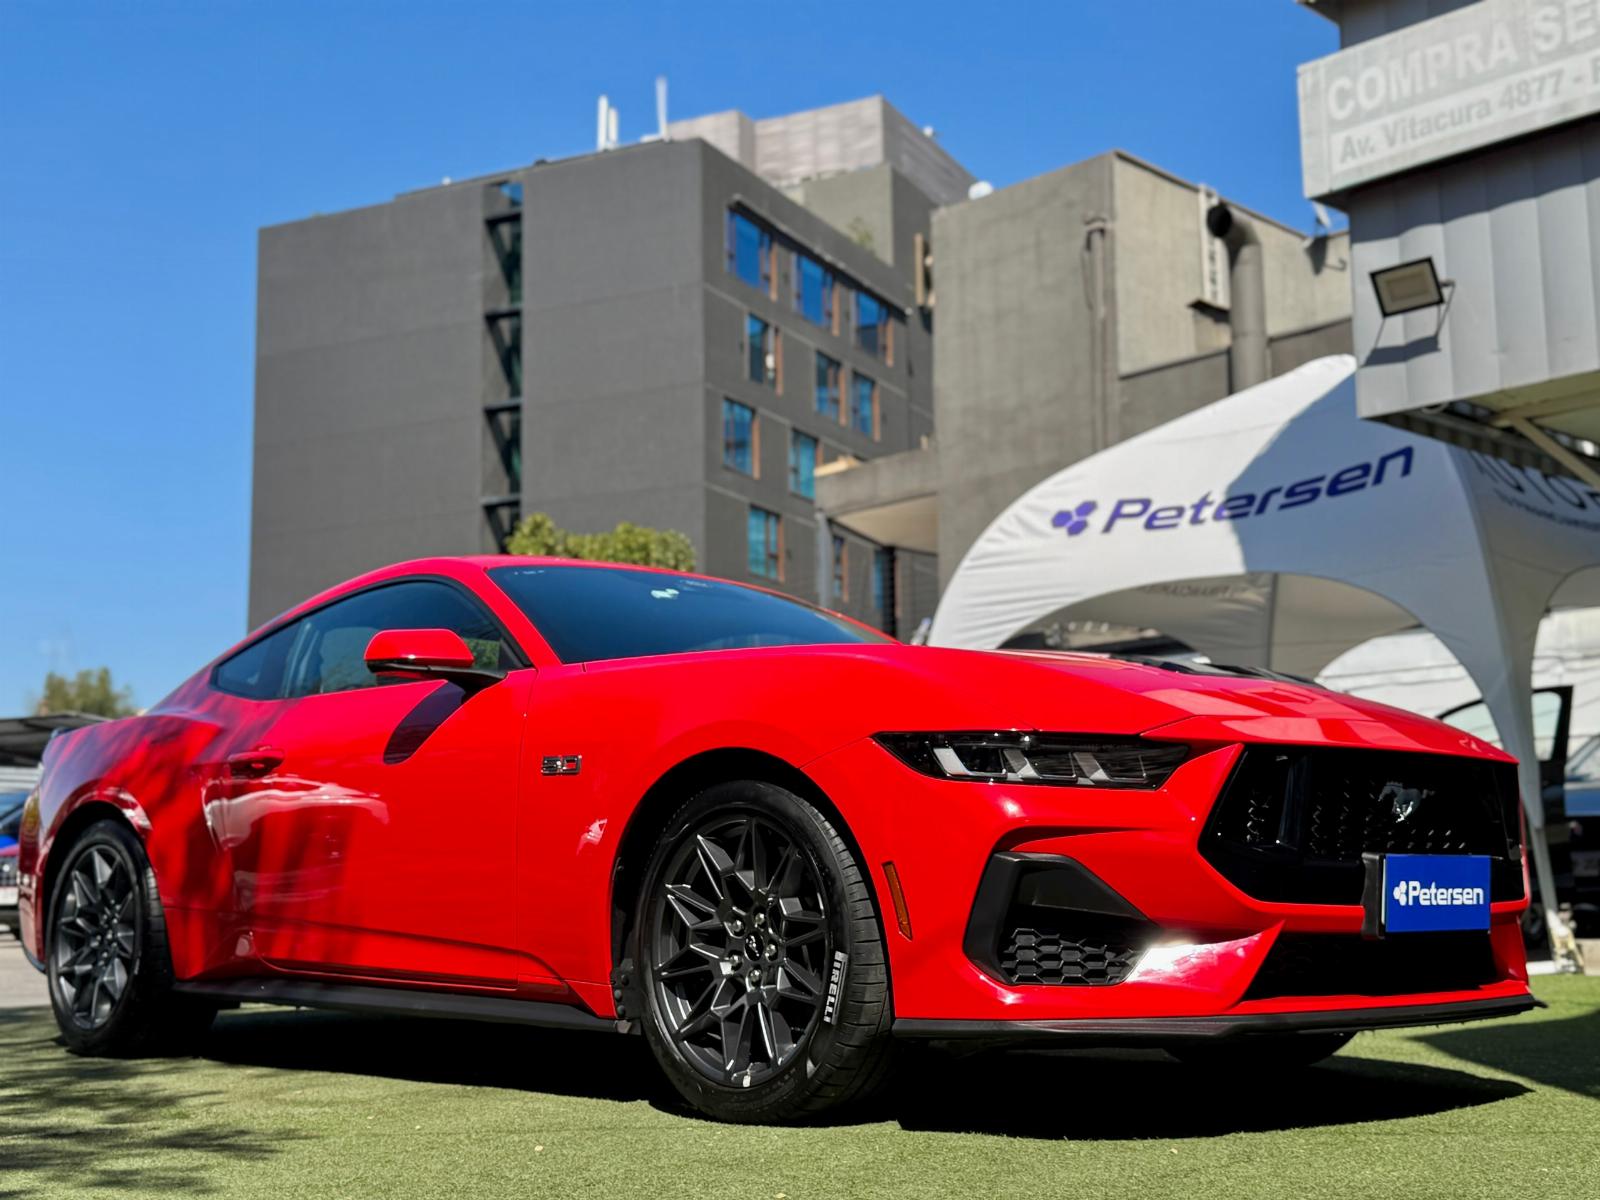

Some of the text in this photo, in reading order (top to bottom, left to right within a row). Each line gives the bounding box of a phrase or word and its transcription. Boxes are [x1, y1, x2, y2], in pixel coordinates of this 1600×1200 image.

[1327, 0, 1600, 120] COMPRA SE
[1340, 134, 1376, 164] Av.
[1382, 98, 1491, 149] Vitacura
[1498, 68, 1564, 110] 4877
[1101, 446, 1414, 533] Petersen
[1408, 881, 1484, 906] Petersen
[823, 950, 848, 1024] PIRELLI
